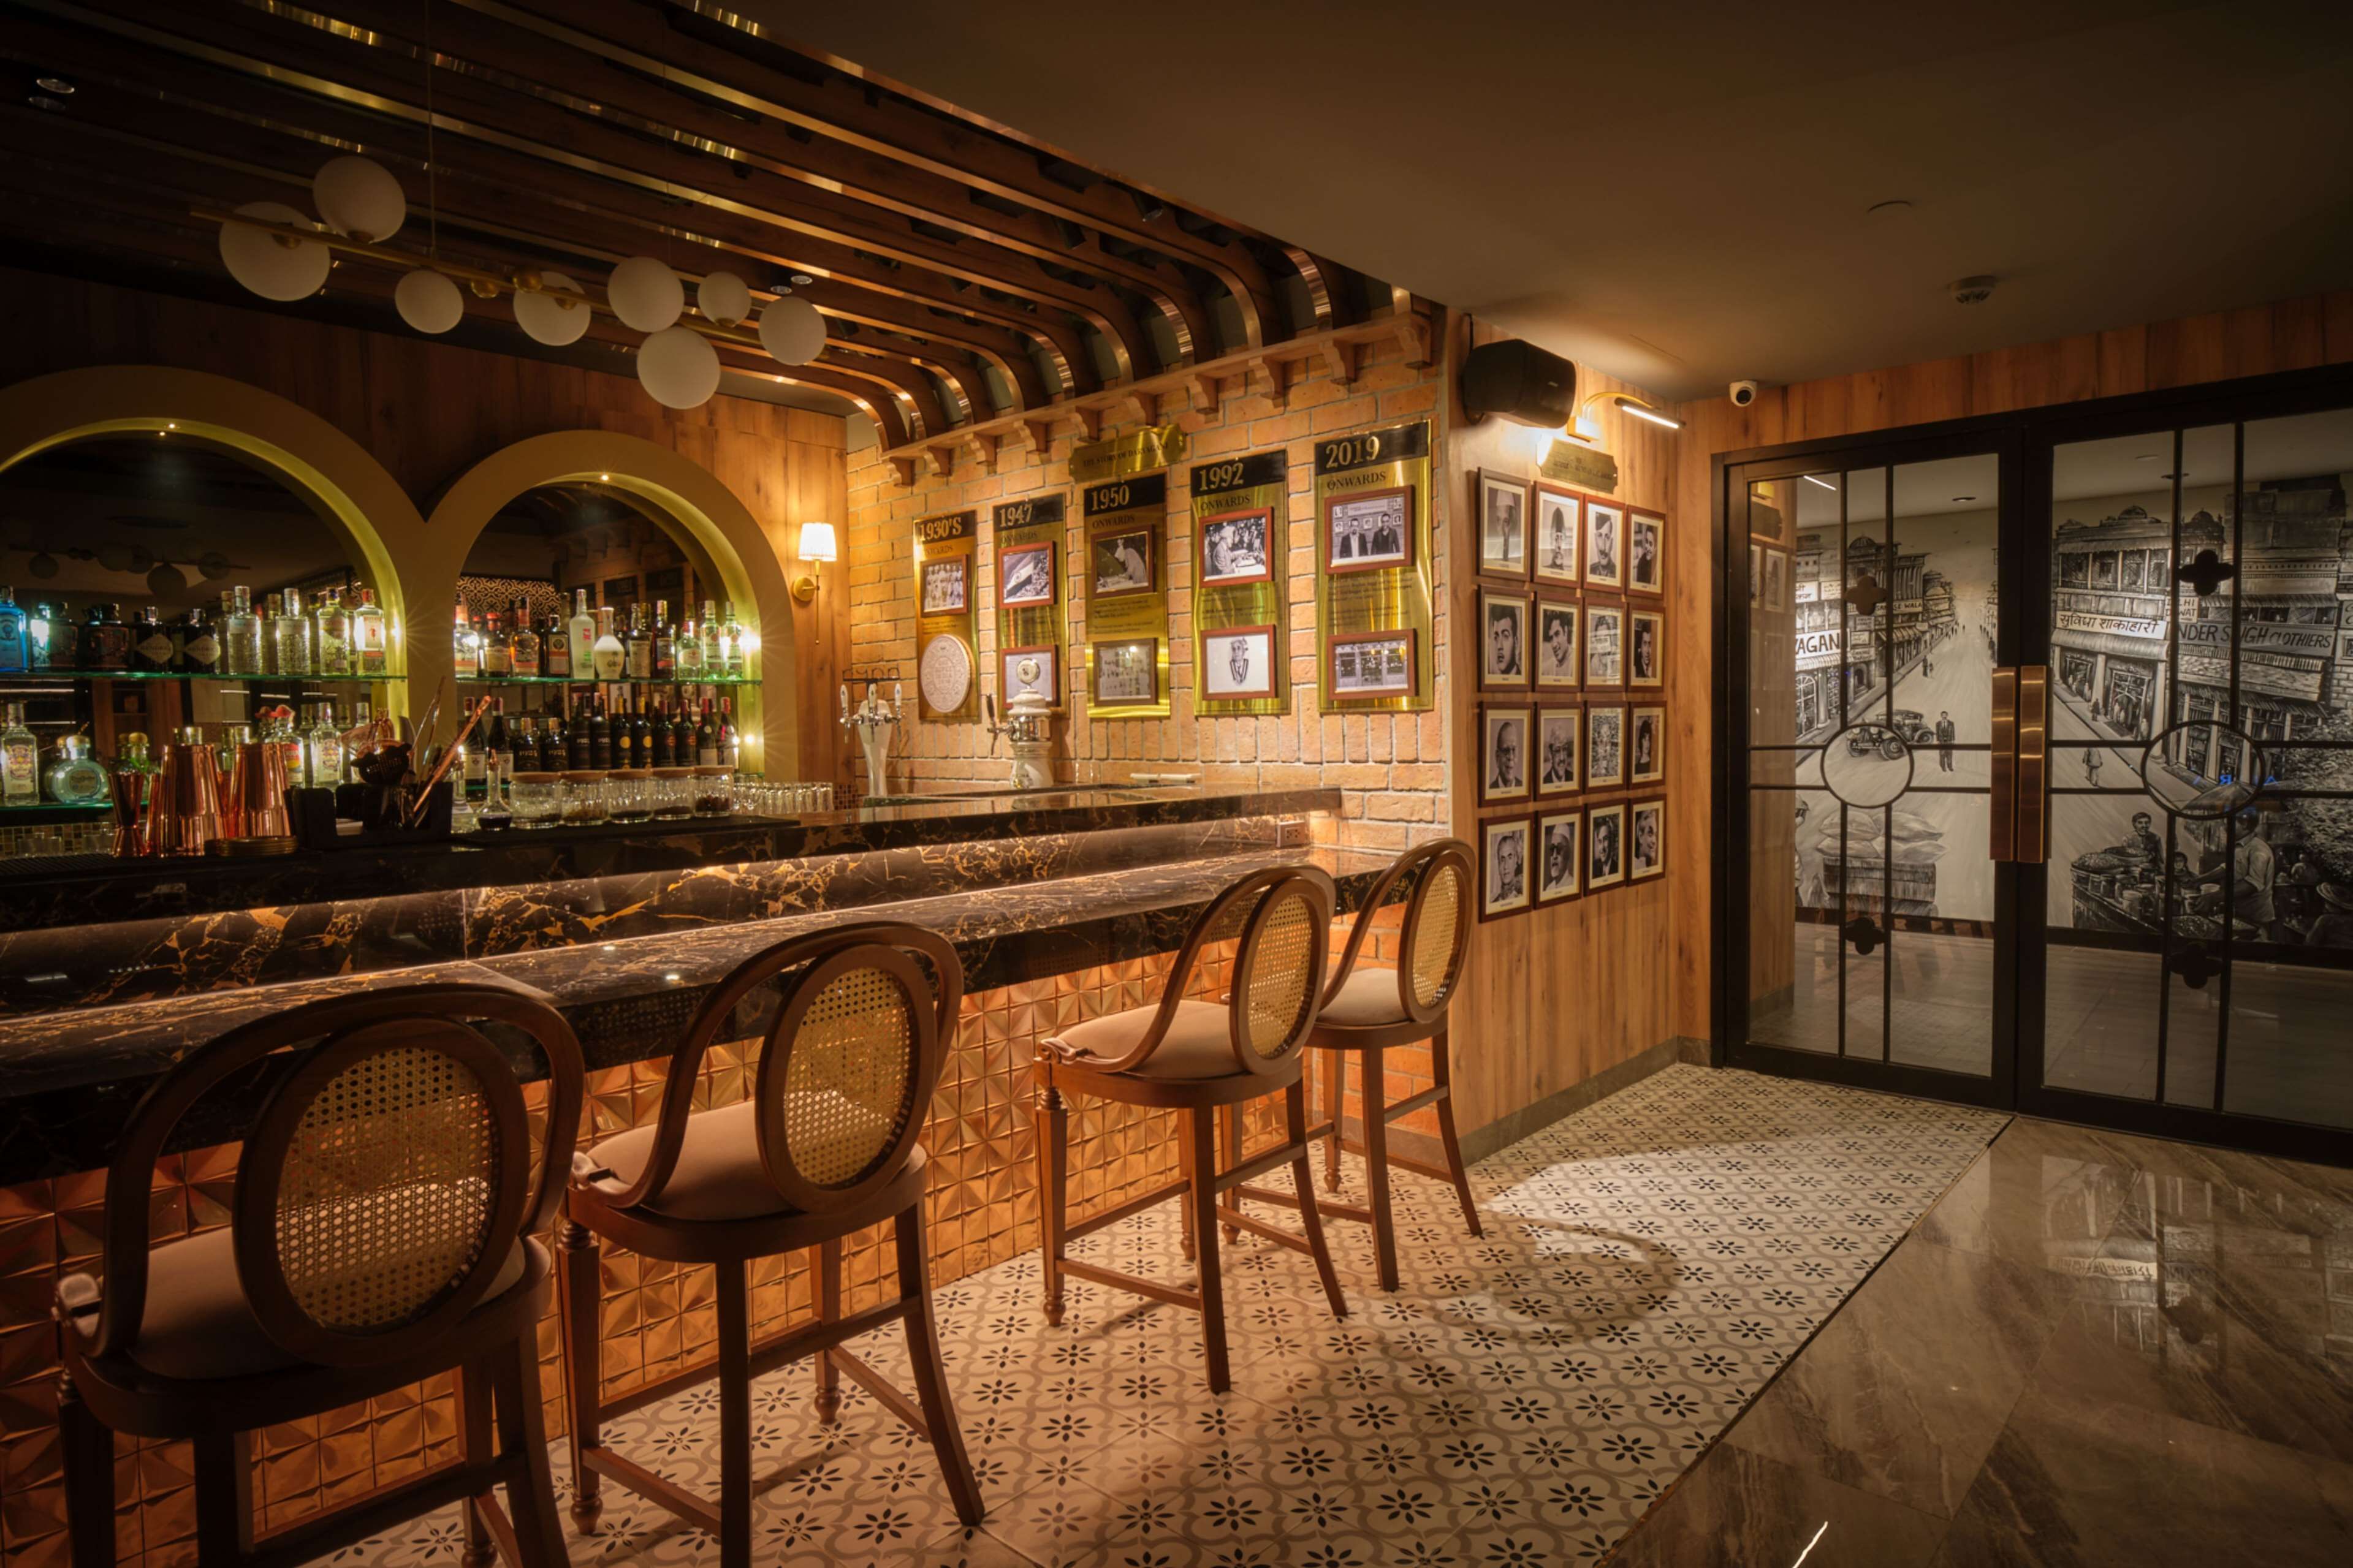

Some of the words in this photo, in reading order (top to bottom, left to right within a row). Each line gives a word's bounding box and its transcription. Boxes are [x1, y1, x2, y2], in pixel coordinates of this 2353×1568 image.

[1326, 436, 1380, 468] 2019
[1199, 462, 1244, 491] 1992
[1326, 471, 1386, 490] ONWARDS
[1091, 485, 1130, 511] 1950
[1201, 494, 1250, 511] ONWARDS
[1000, 503, 1033, 528] 1947
[1092, 515, 1135, 529] ONWARDS
[919, 517, 962, 541] 1930'S
[1796, 632, 1840, 654] AGAN
[2221, 624, 2269, 643] SNGH
